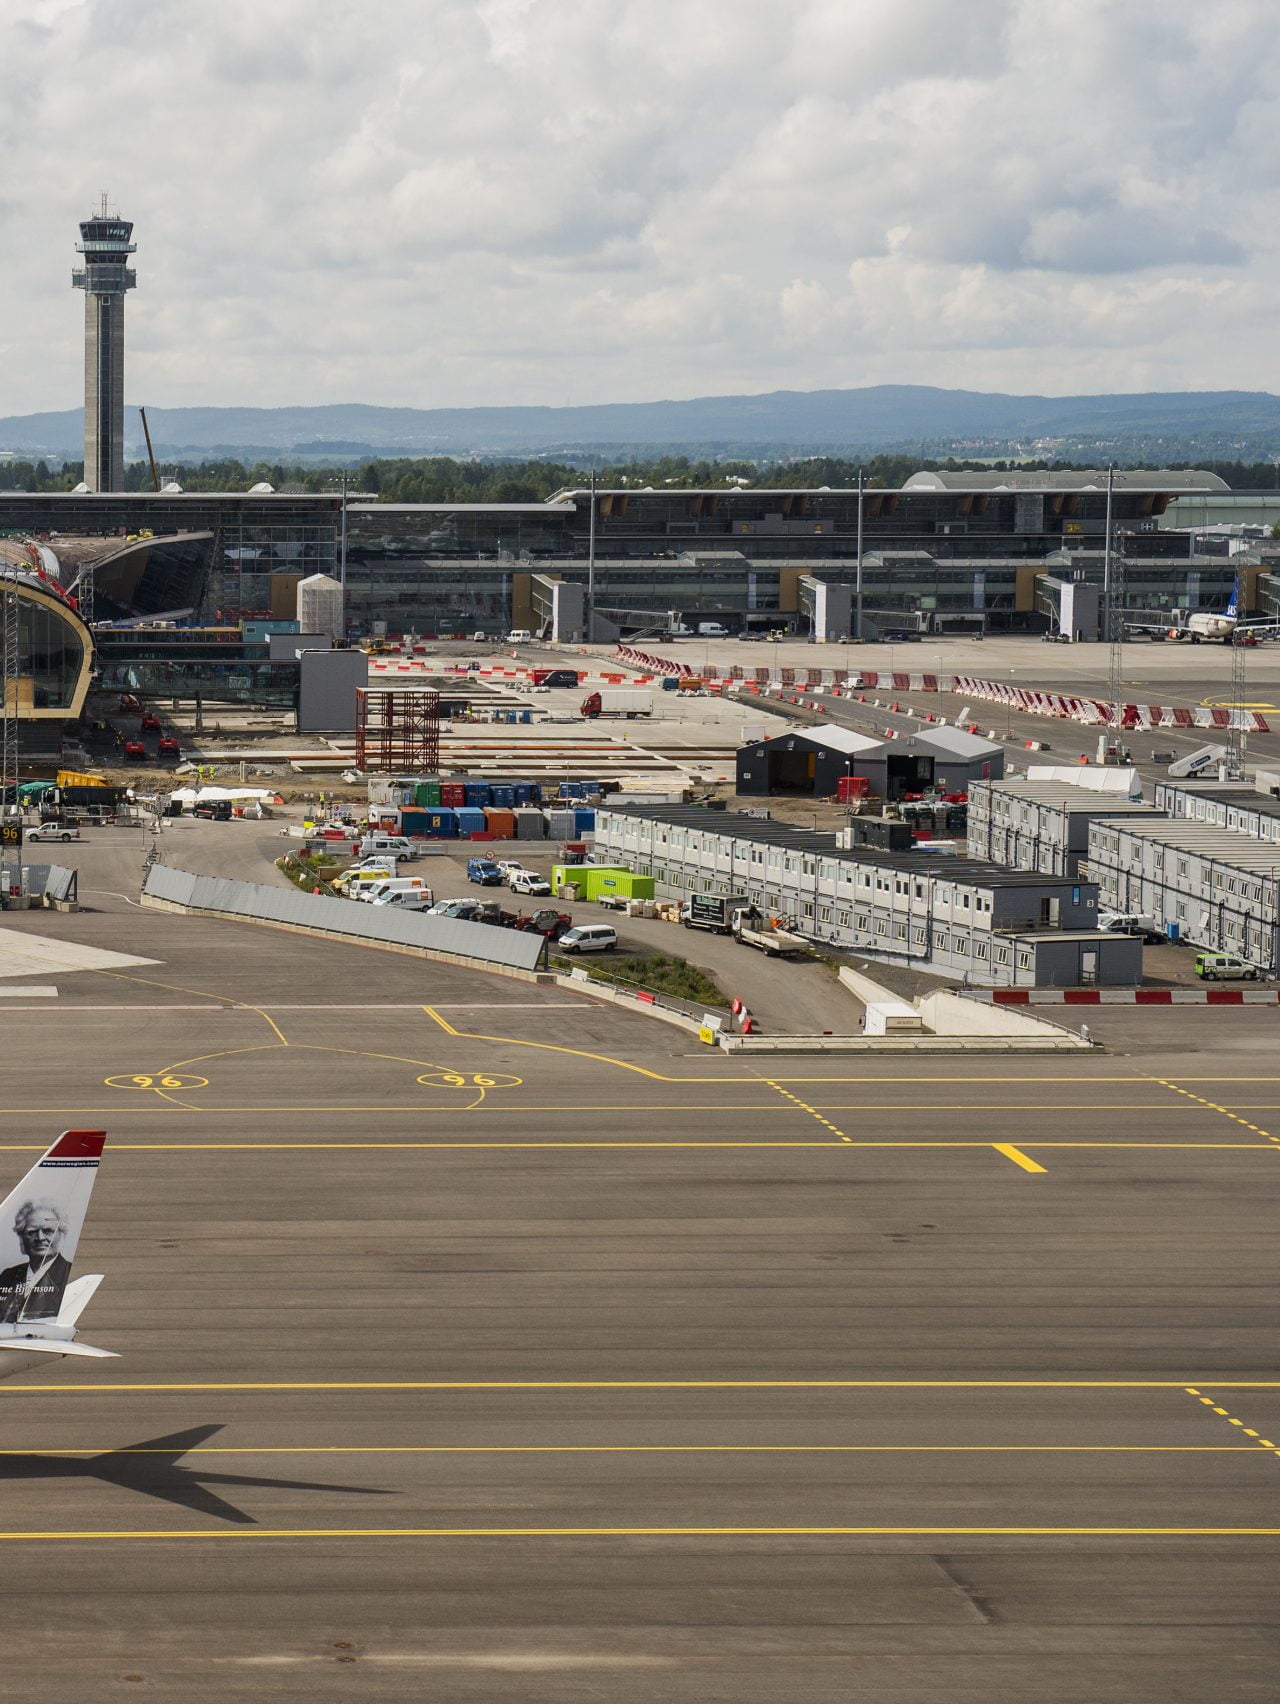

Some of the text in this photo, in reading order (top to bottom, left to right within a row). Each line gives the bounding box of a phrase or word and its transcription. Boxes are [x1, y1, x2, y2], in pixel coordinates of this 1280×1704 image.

[3, 827, 18, 839] 96
[132, 1076, 182, 1088] 96
[443, 1075, 496, 1086] 96
